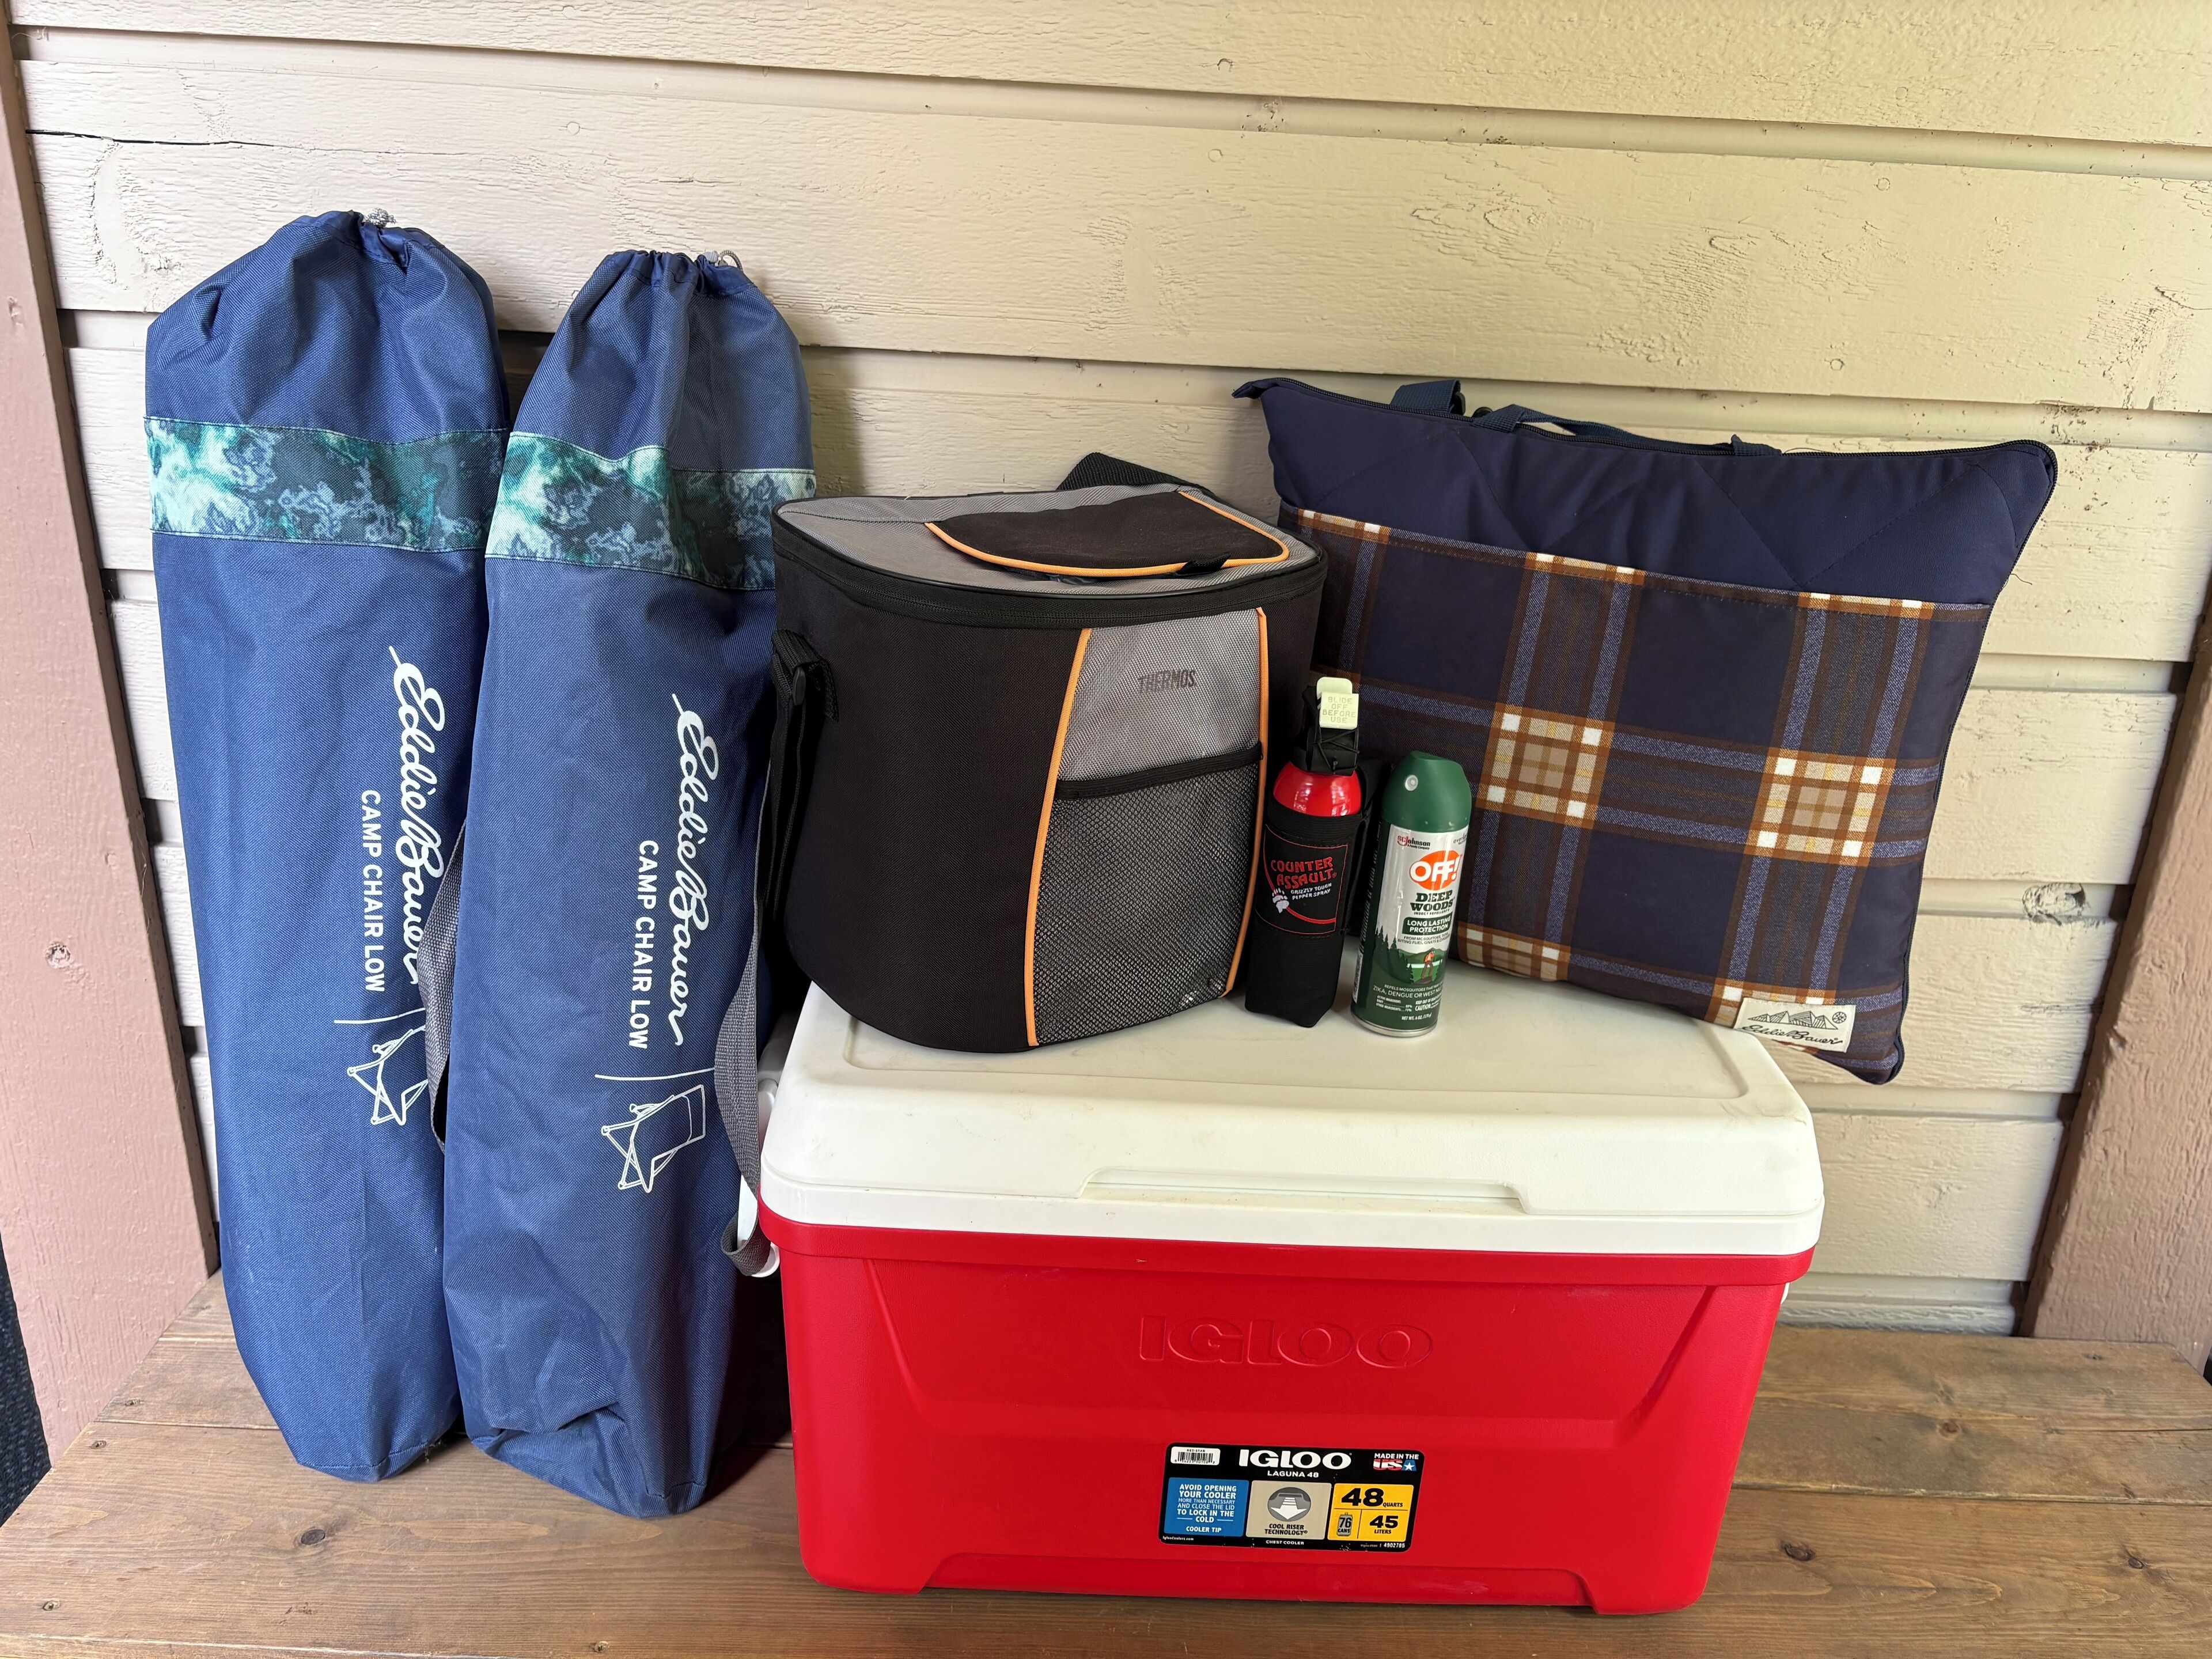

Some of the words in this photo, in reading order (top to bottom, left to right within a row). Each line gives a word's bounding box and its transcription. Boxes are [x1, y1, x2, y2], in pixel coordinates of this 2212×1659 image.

[1138, 669, 1196, 694] THERMOS
[1322, 709, 1356, 718] BEFORE
[361, 790, 382, 858] CAMP
[1271, 856, 1334, 873] COUNTER
[637, 840, 659, 910] CAMP
[1276, 868, 1334, 889] ASSAULT
[1313, 888, 1331, 897] SPRAY
[1314, 882, 1332, 891] TOUGH
[363, 864, 384, 938] CHAIR
[1415, 889, 1453, 902] DEEP
[1410, 899, 1453, 911] WOODS
[1409, 923, 1449, 933] PROTECTION
[1429, 915, 1451, 926] LASTING
[631, 916, 655, 991] CHAIR
[365, 945, 385, 992] LOW
[1373, 985, 1387, 995] ZIKA,
[1388, 990, 1413, 998] DENGUE
[1423, 989, 1435, 997] WEST
[628, 1000, 651, 1049] LOW
[1139, 1315, 1433, 1368] IGLOO
[1239, 1449, 1352, 1470] IGLOO
[1373, 1459, 1417, 1471] USA
[1341, 1487, 1384, 1507] 48
[1339, 1517, 1352, 1528] 76
[1369, 1515, 1399, 1529] 45
